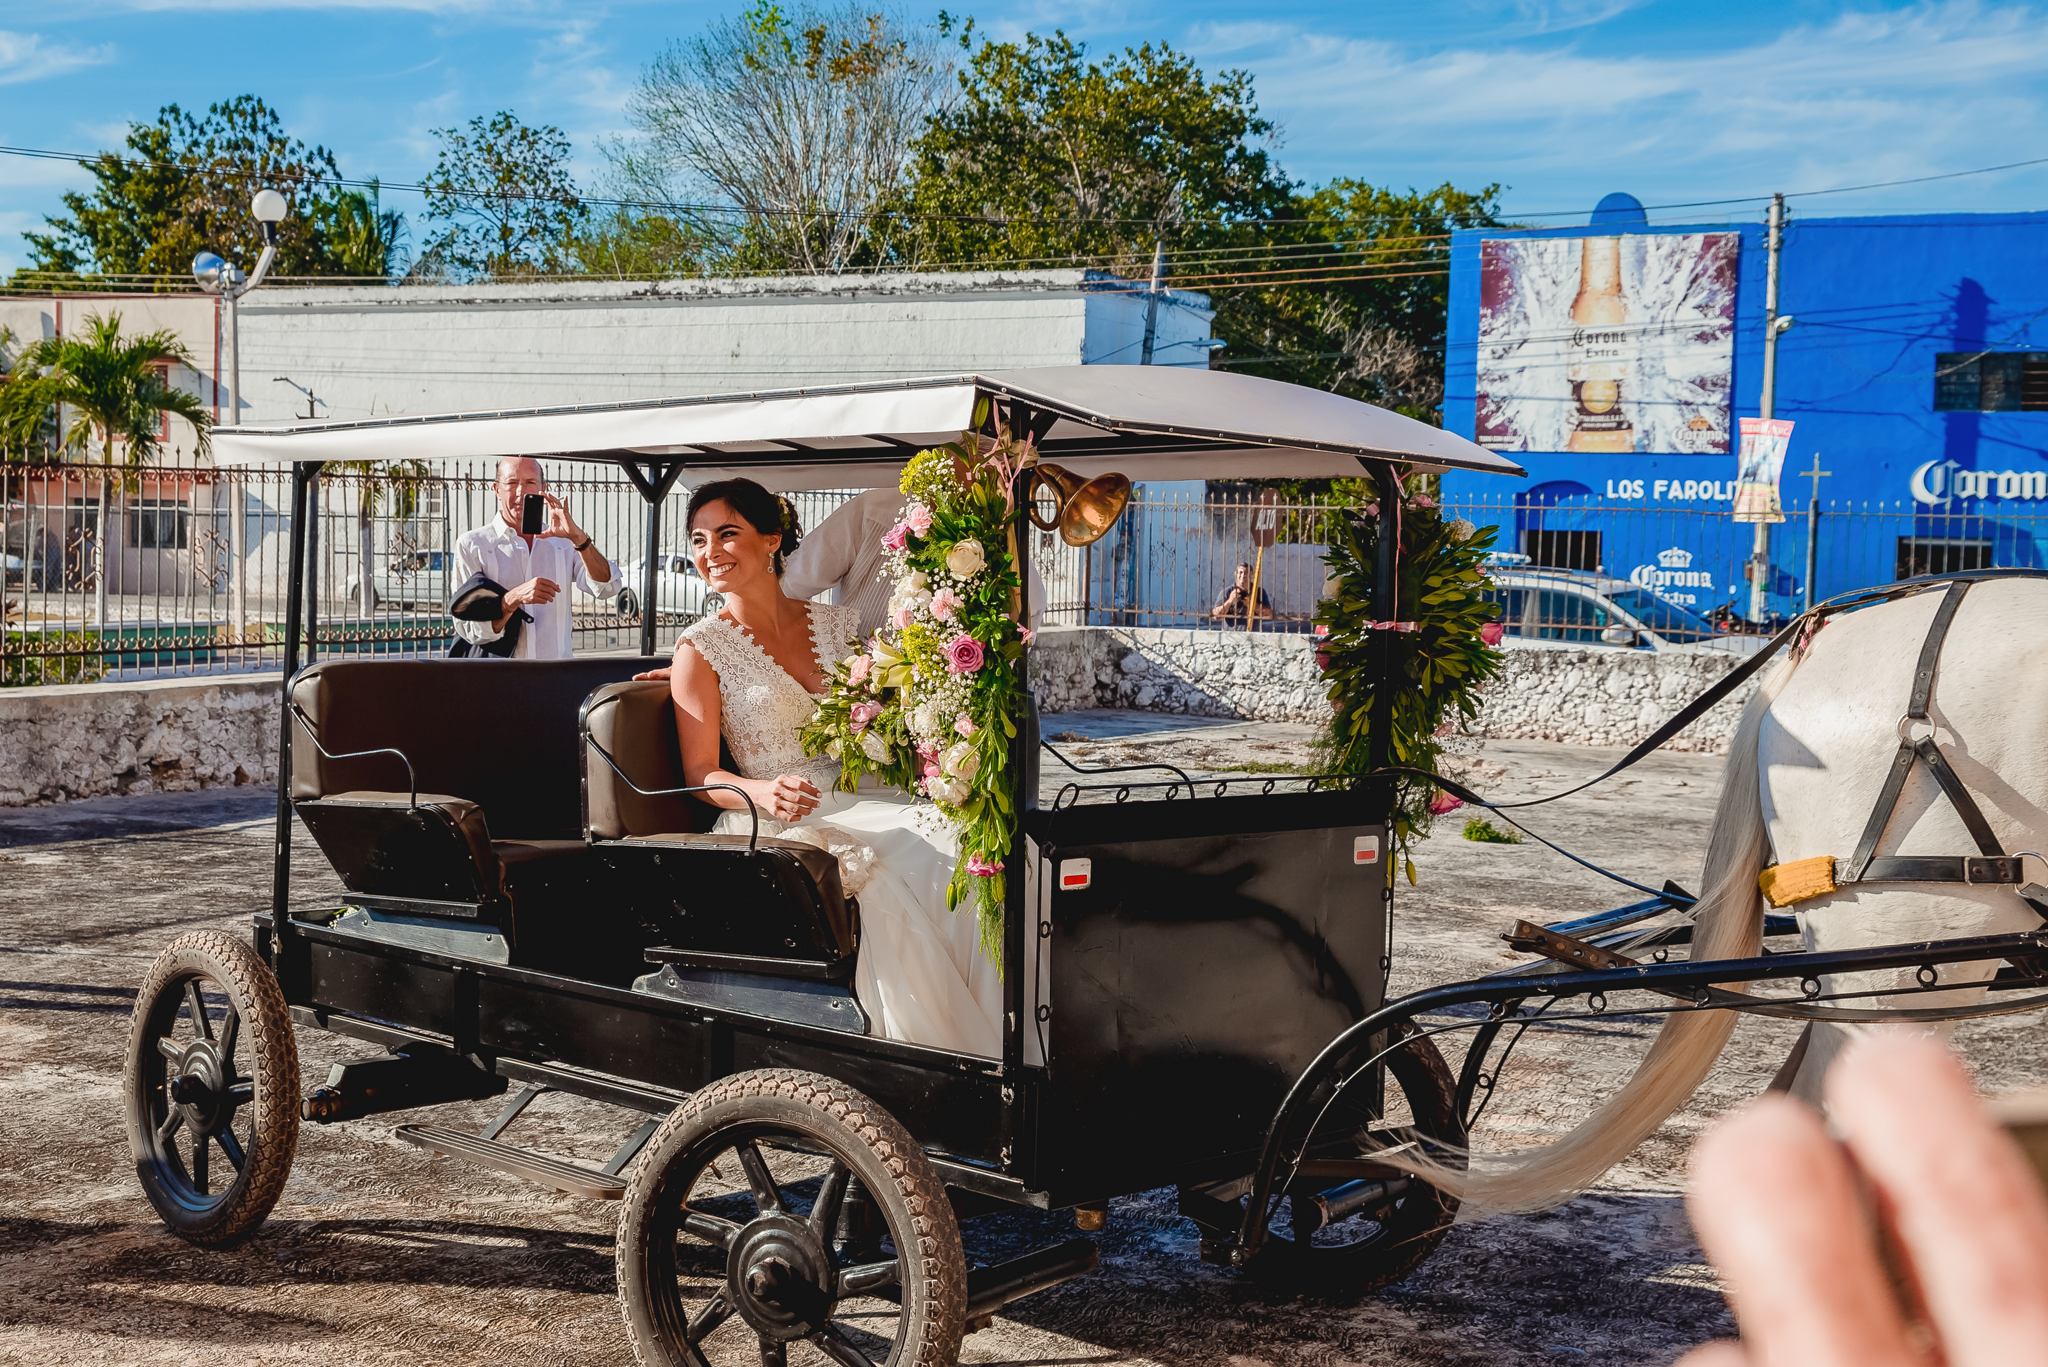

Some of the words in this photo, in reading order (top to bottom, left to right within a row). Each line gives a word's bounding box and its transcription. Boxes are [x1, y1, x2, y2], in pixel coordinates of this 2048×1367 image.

[1606, 479, 1644, 499] LOS
[1653, 479, 1737, 500] FAROLI
[1910, 459, 2048, 505] Coron
[1255, 509, 1276, 530] ALTO
[1630, 564, 1715, 591] Corona
